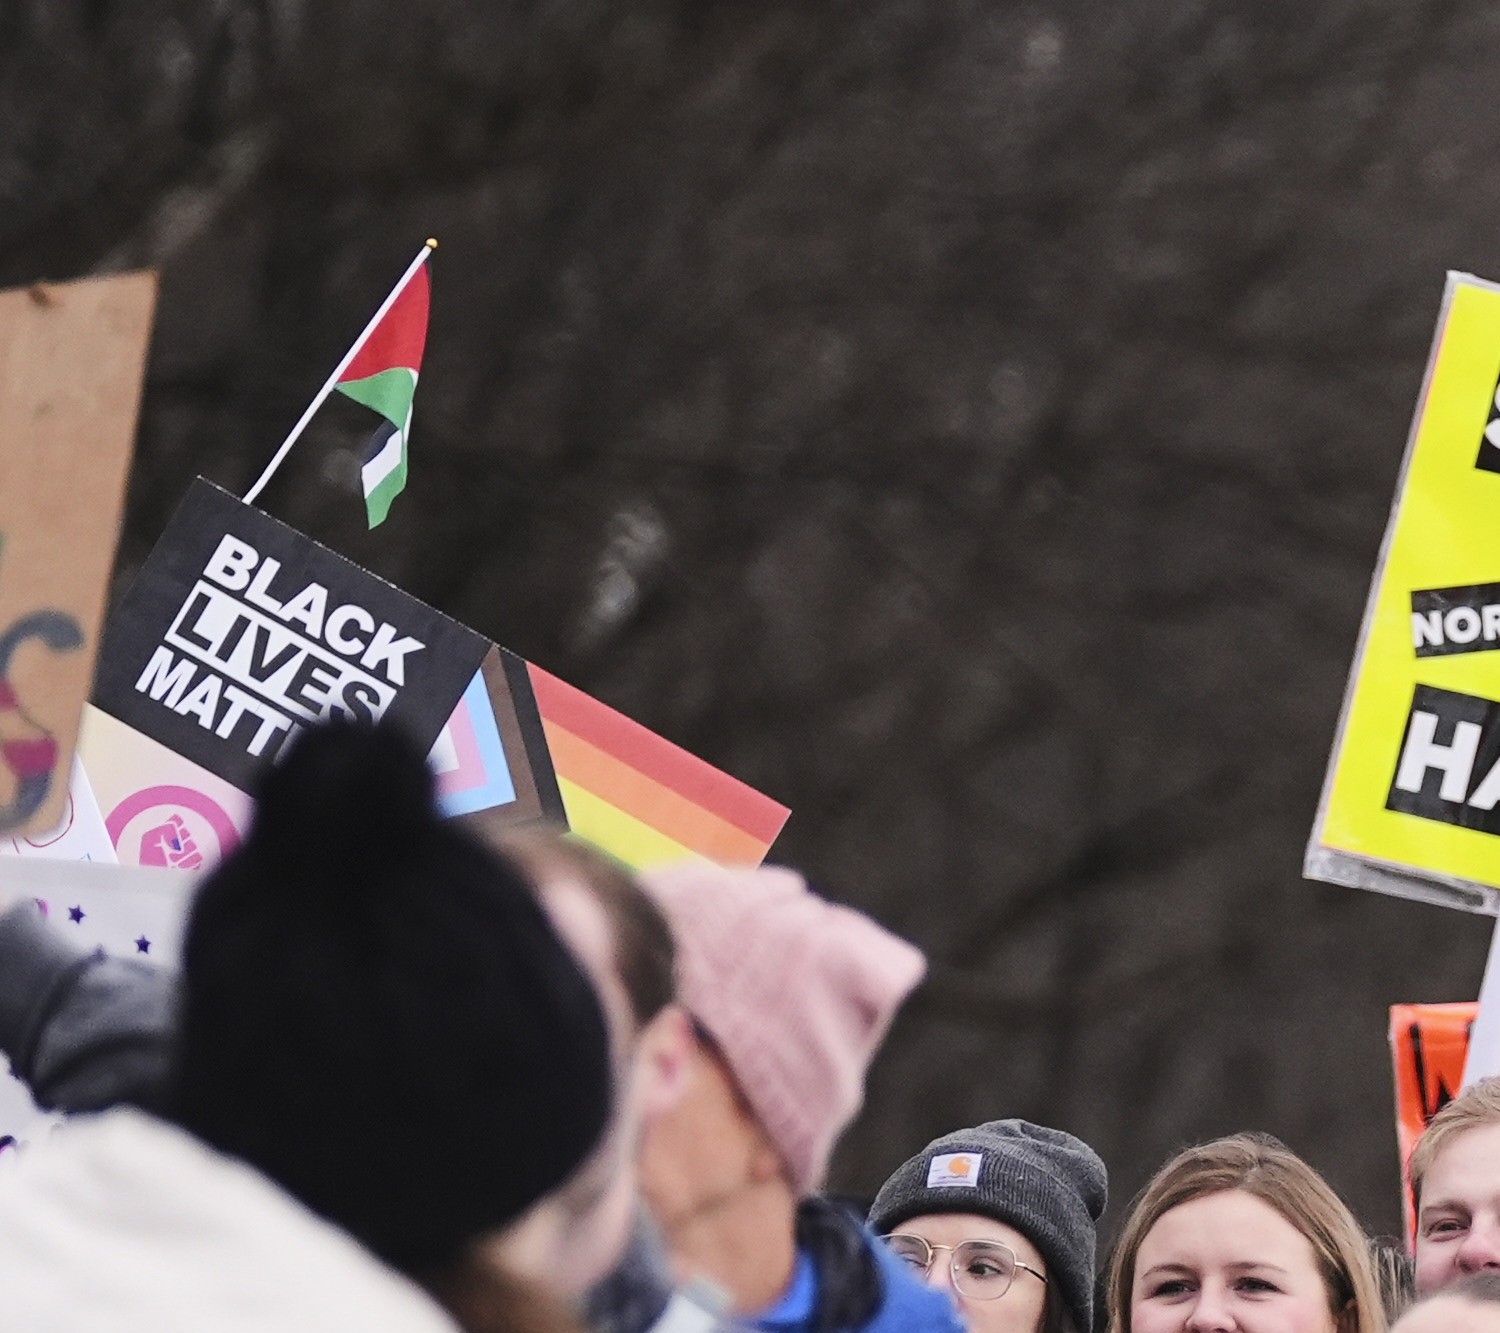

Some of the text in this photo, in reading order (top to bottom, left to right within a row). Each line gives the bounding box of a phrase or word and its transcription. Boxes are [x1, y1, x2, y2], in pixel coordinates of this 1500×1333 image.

[172, 588, 382, 724] LIVES
[203, 533, 426, 686] BLACK
[135, 645, 298, 766] MATT
